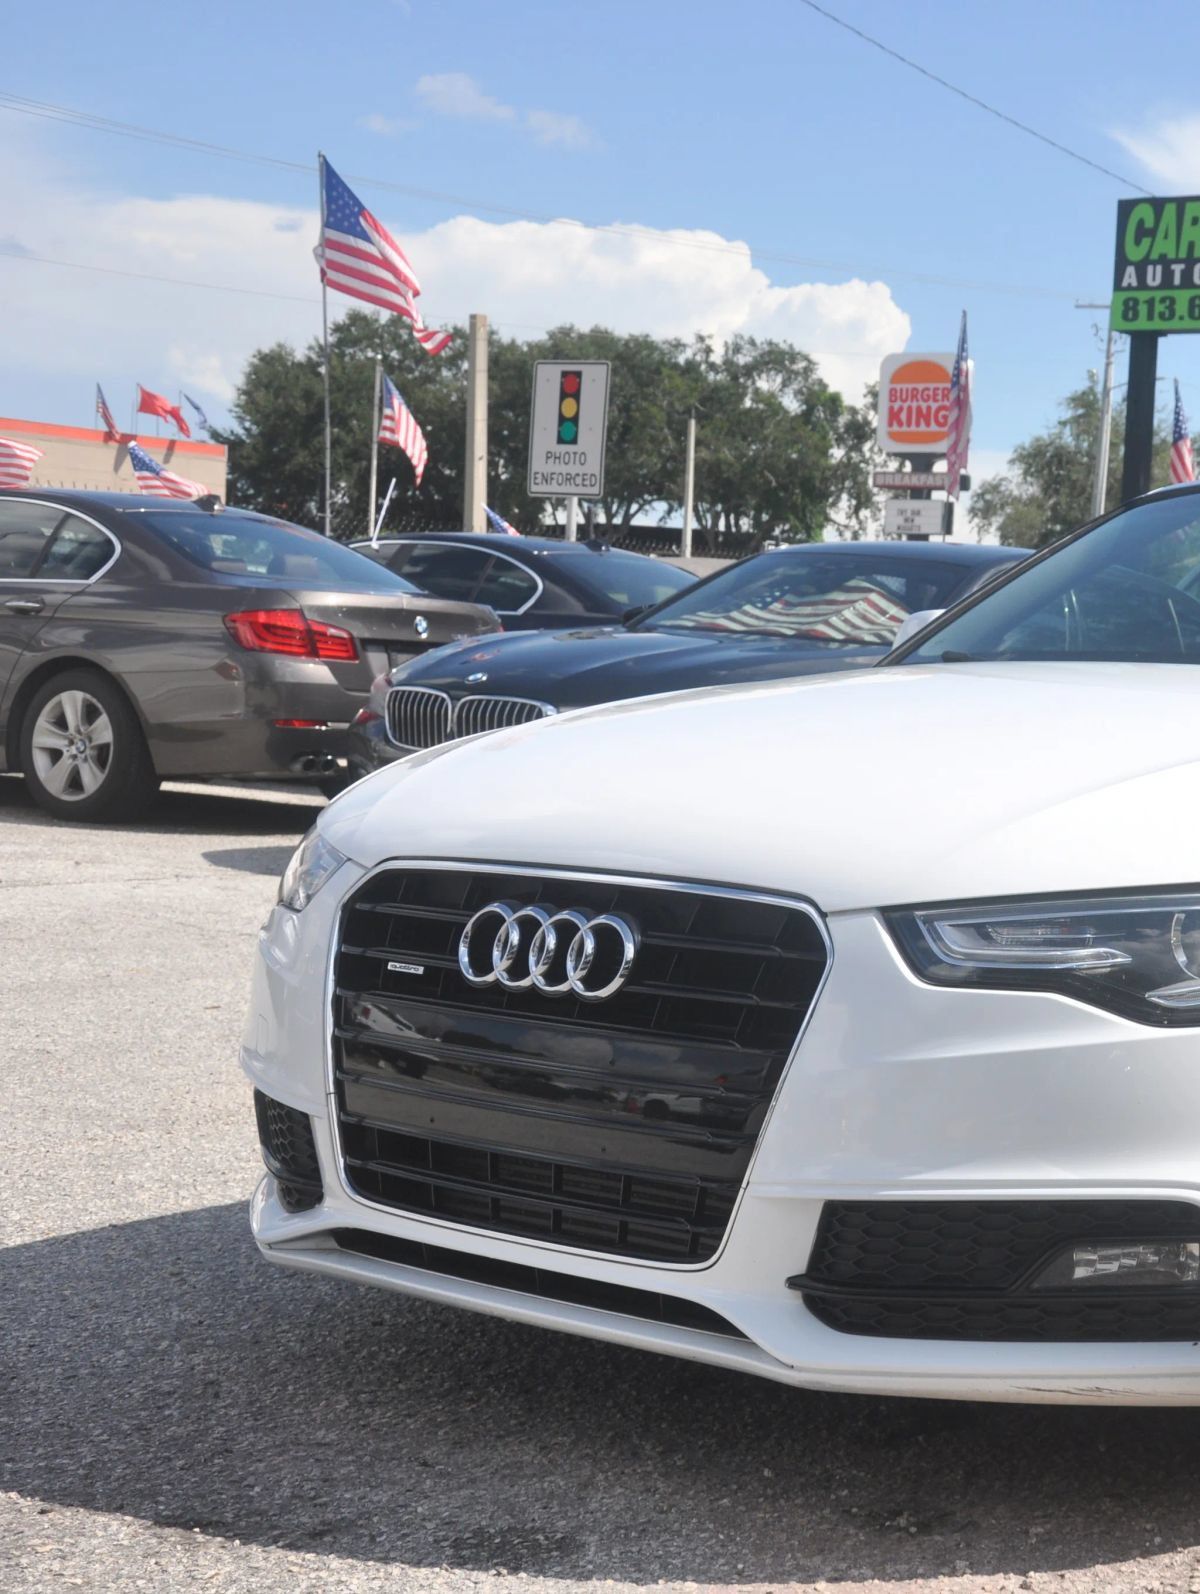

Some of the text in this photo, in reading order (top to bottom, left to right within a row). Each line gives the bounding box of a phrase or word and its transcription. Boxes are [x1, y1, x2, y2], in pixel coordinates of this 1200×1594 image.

[888, 386, 950, 403] BURGER
[887, 404, 950, 429] KING
[545, 451, 587, 466] PHOTO
[533, 471, 597, 487] ENFORCED
